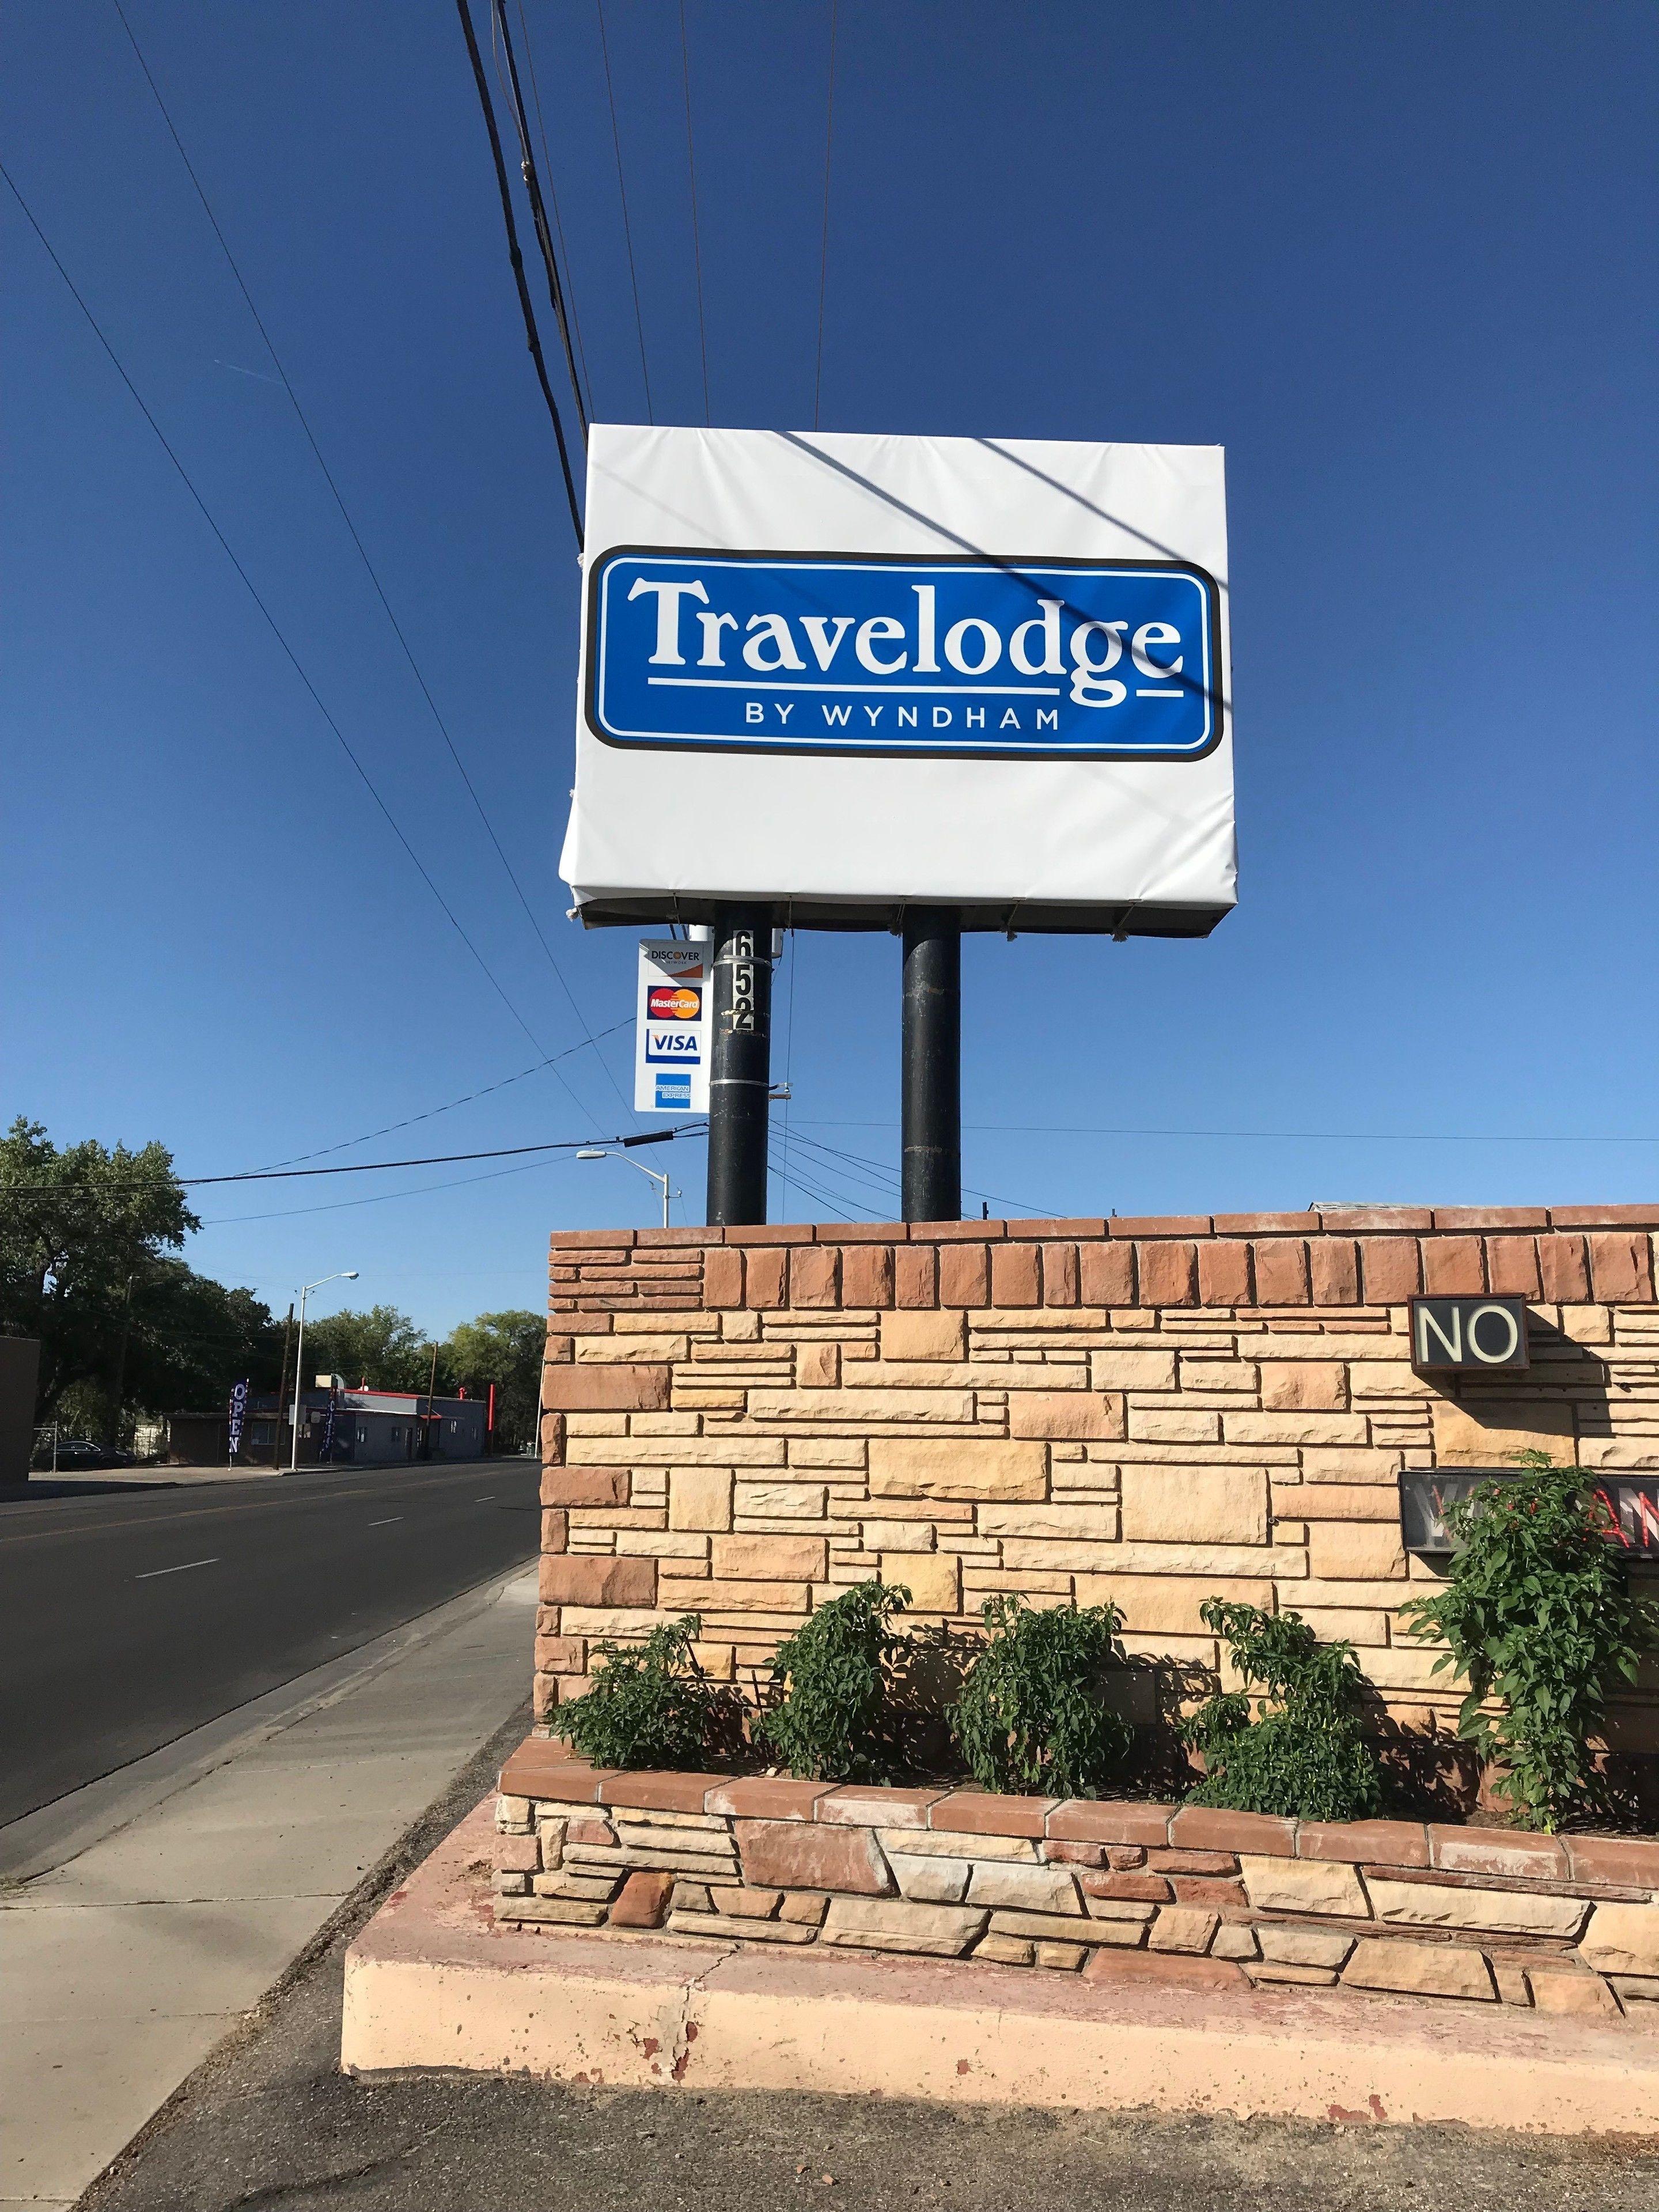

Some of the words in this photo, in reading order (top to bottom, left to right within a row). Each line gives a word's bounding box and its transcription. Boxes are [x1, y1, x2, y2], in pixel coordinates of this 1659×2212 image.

[627, 577, 1184, 708] Travelodge
[745, 702, 795, 725] BY
[821, 704, 1059, 730] WYNDHAM
[652, 950, 699, 960] DISCOVER
[650, 998, 699, 1009] MasterCard
[652, 1035, 698, 1051] VISA
[1418, 1304, 1518, 1363] NO
[230, 1384, 245, 1453] OPEN
